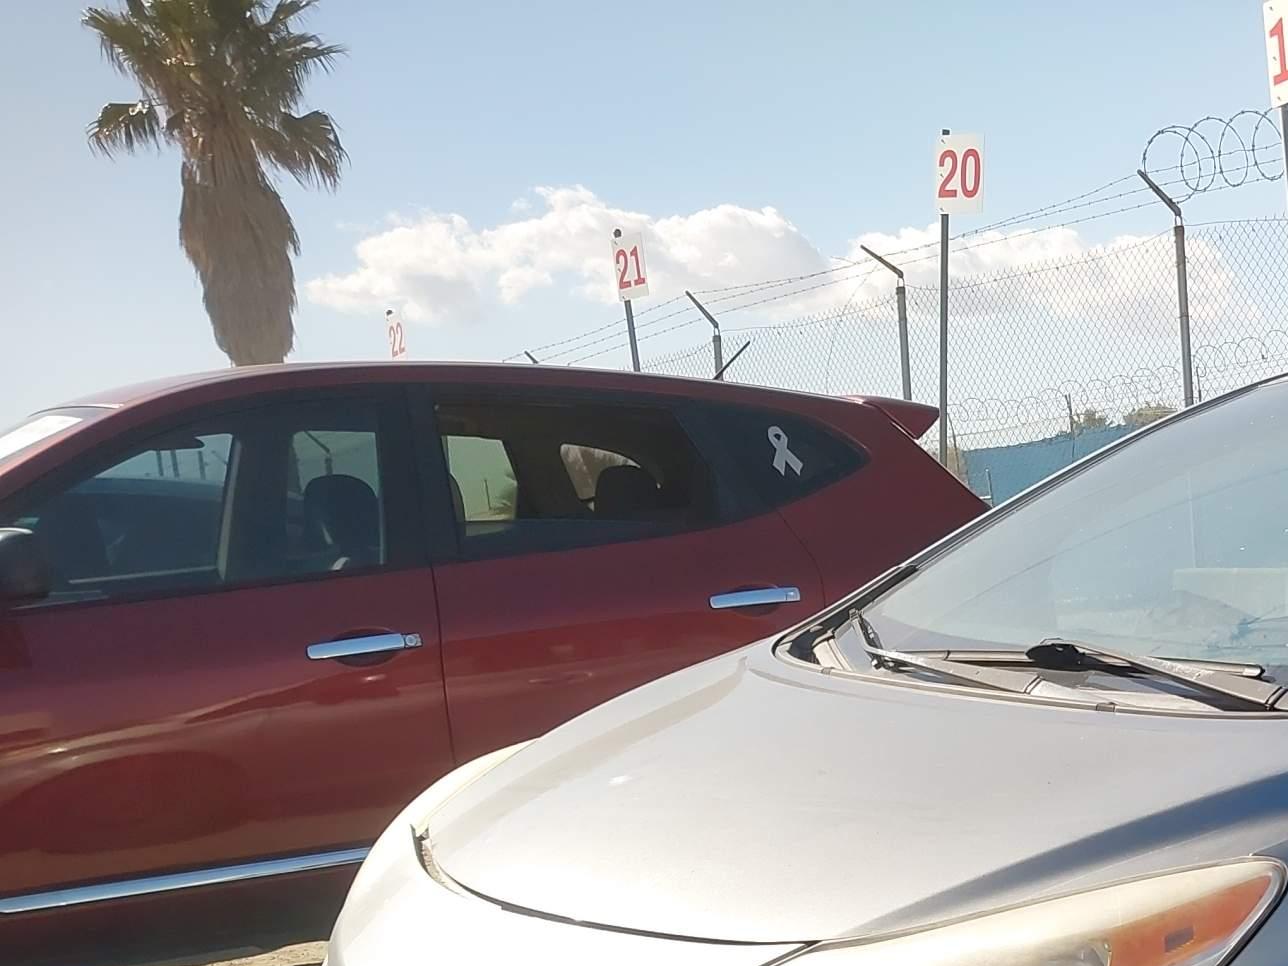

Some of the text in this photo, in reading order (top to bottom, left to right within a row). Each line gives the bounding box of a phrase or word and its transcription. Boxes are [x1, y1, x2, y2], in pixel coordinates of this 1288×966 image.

[938, 148, 981, 199] 20
[616, 246, 645, 289] 21
[389, 322, 405, 357] 22
